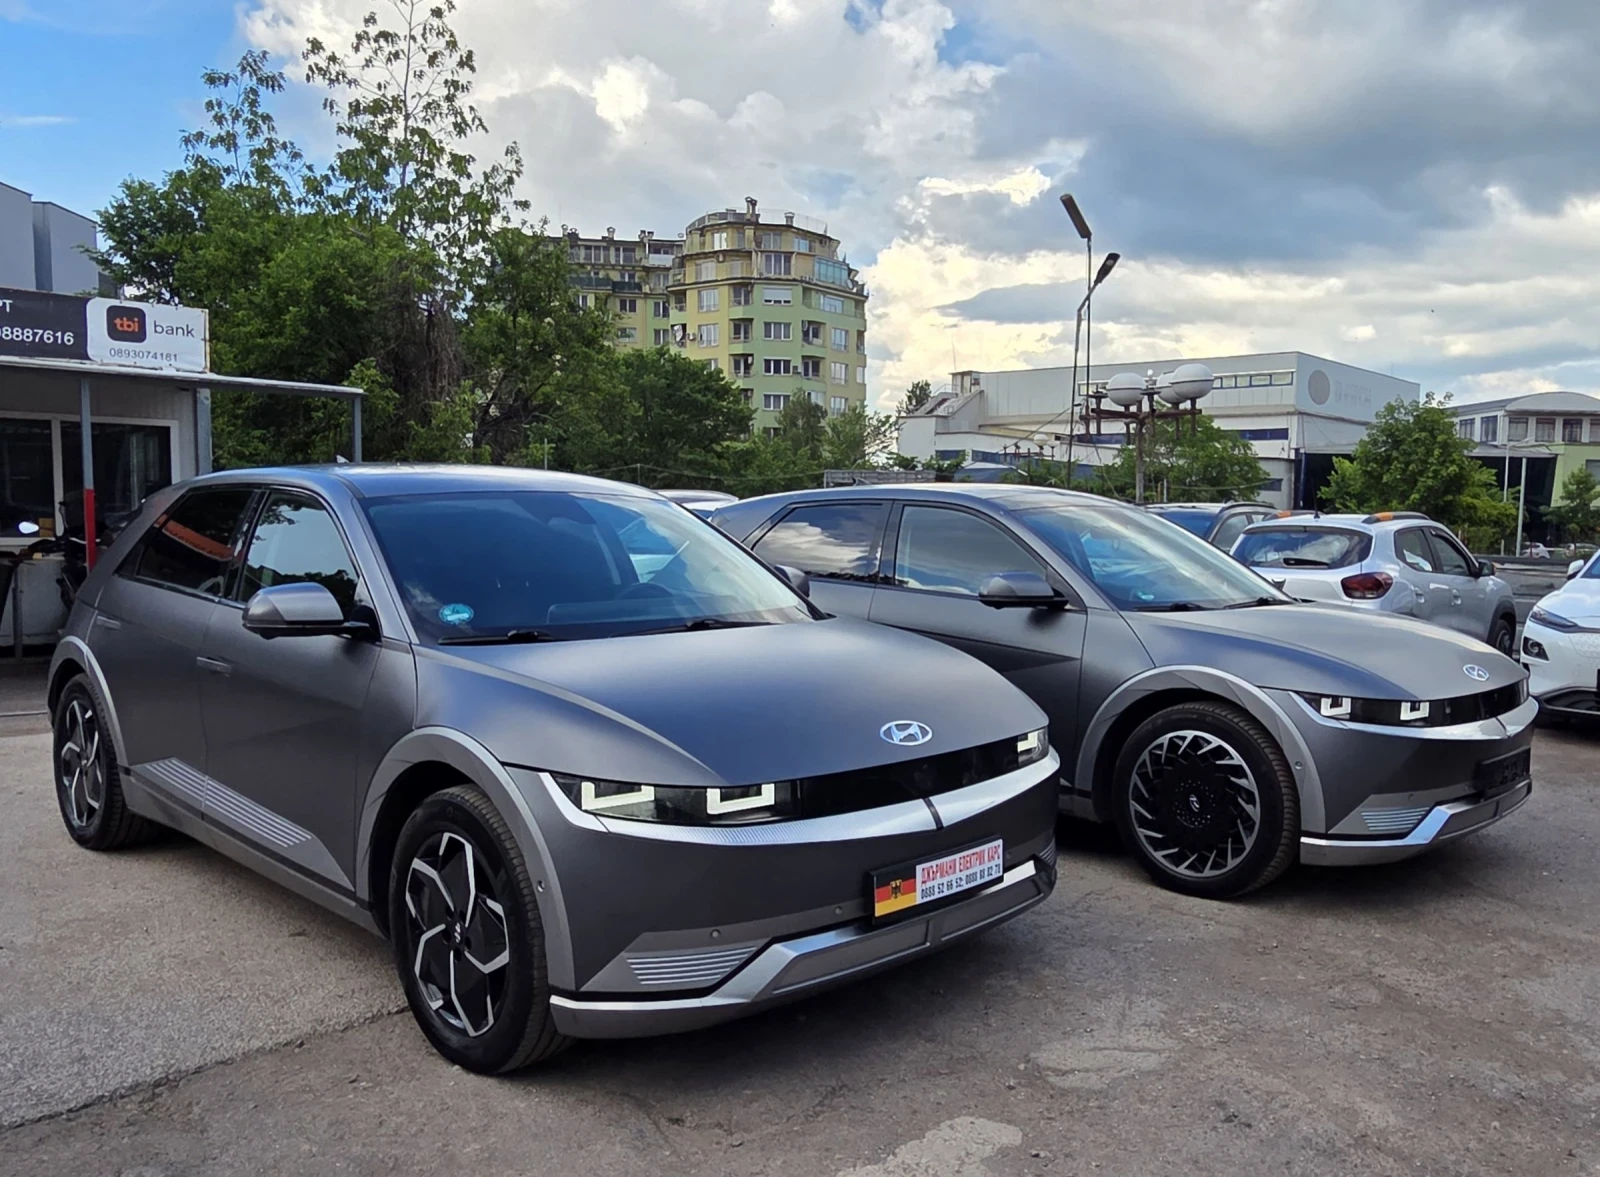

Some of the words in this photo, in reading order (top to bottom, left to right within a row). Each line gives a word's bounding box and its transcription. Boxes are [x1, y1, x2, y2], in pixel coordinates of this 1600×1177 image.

[0, 326, 75, 346] 8887616
[114, 317, 139, 332] tbi
[153, 320, 195, 338] bank
[109, 347, 178, 362] 0893074181
